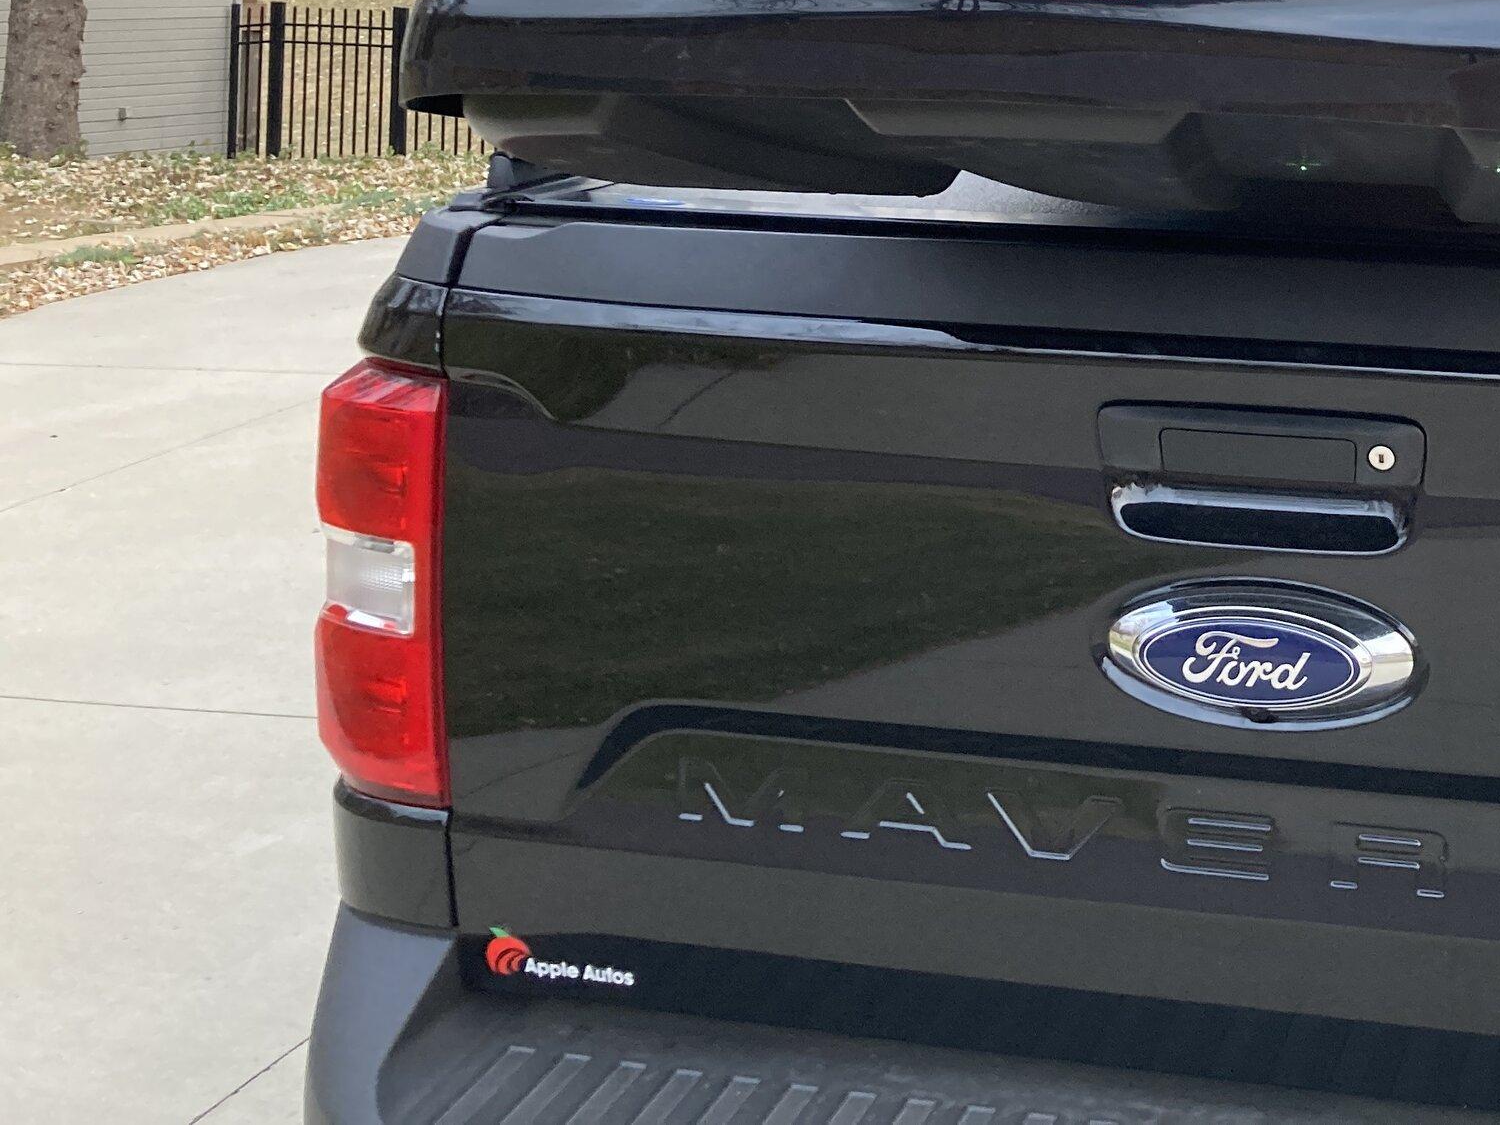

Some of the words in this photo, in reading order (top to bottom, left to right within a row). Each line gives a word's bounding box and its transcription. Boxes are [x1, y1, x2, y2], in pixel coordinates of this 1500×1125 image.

[1182, 630, 1311, 691] Ford
[523, 957, 580, 979] Apple
[582, 964, 636, 986] Autos
